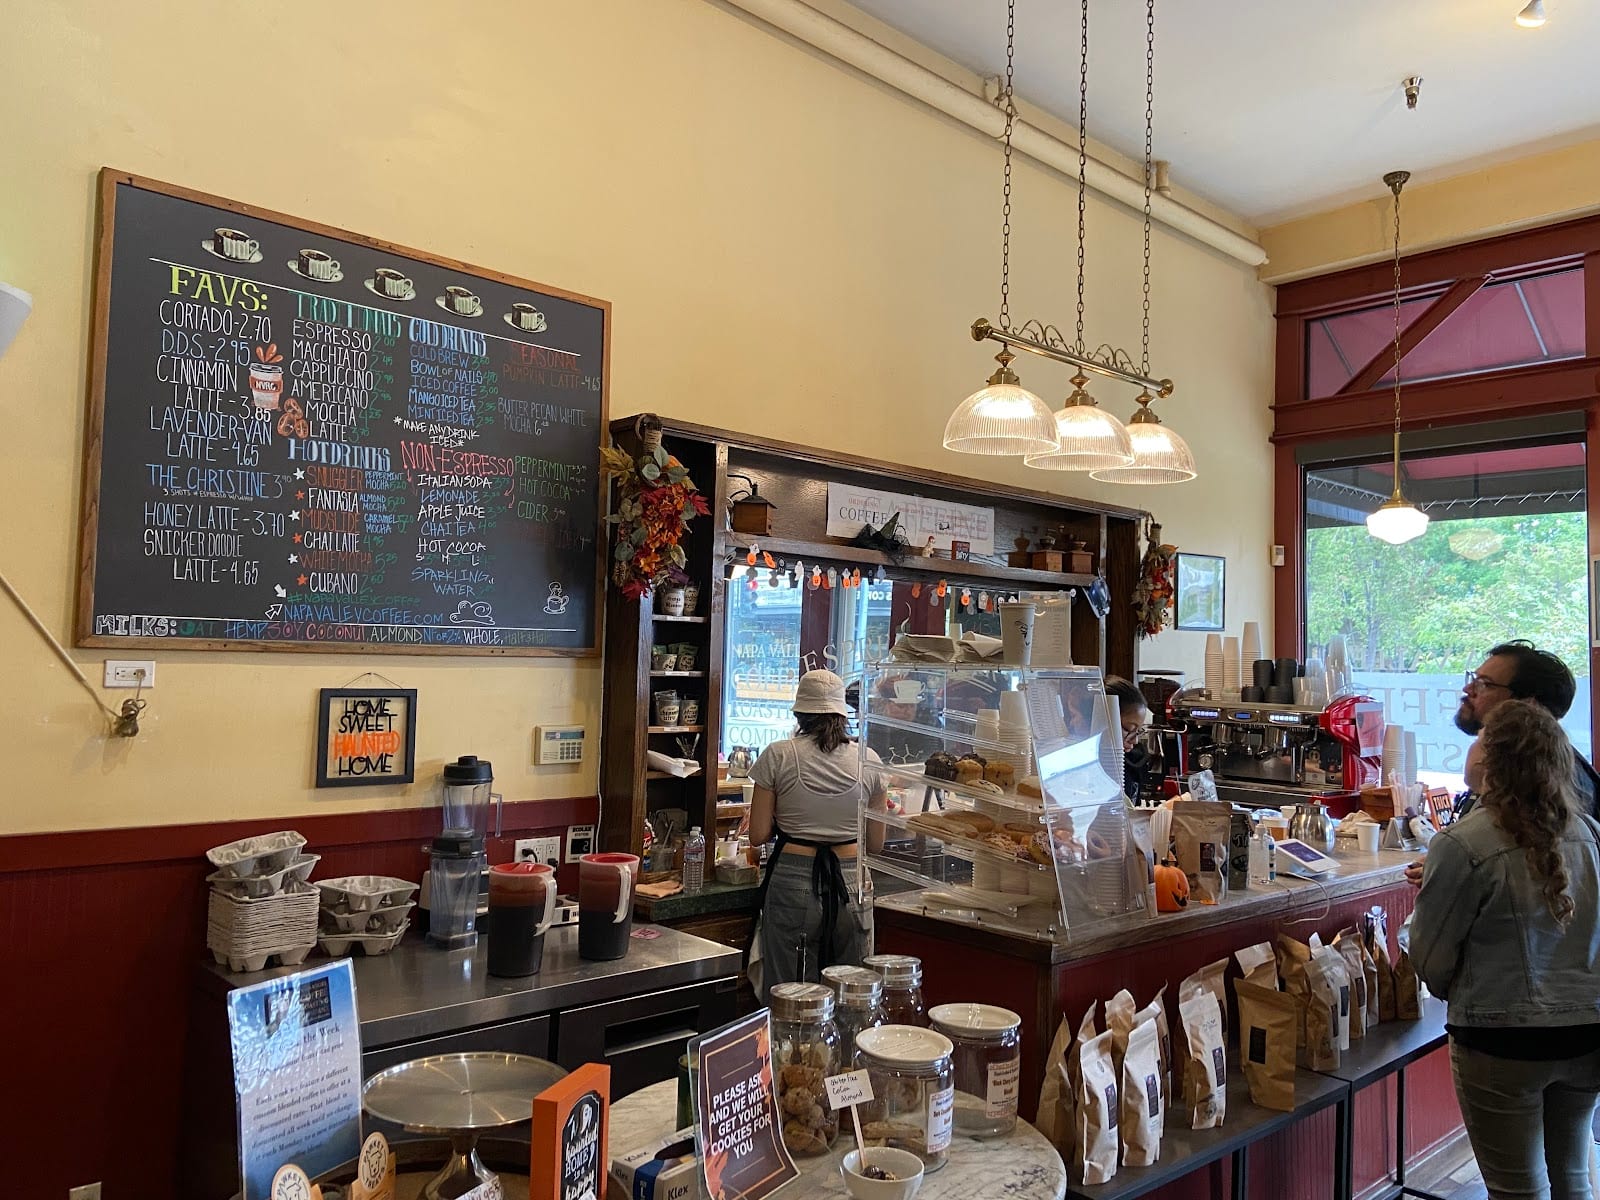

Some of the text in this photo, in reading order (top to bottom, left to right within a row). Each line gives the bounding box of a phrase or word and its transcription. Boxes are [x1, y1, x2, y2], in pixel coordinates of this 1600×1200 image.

[170, 265, 268, 312] FAVS:
[293, 319, 372, 351] ESPRESSO
[408, 317, 487, 357] COLD DRINKS
[292, 339, 367, 371] MACCHIATO
[410, 344, 469, 369] COLD BREW
[156, 355, 237, 392] CINNAMON
[290, 359, 373, 391] CAPPUCCINO
[410, 360, 442, 377] BOWL
[455, 370, 483, 385] NAILS
[551, 372, 581, 388] LATTE
[291, 379, 369, 409] AMERICANO
[412, 375, 477, 397] ICED COFFEE
[174, 386, 224, 414] LATTE
[408, 388, 441, 406] MANGO
[441, 394, 458, 408] ICED
[460, 397, 476, 412] TEA
[305, 401, 357, 426] MOCHA
[408, 405, 475, 427] MINT ICED TEA
[498, 397, 587, 427] BUTTER PECAN WHITE
[310, 421, 347, 442] LATTE
[428, 424, 448, 436] ANY
[448, 426, 480, 440] DRINK
[504, 414, 533, 435] MOCHA
[167, 432, 216, 461] LATTE
[400, 440, 514, 477] NON-ESPRESSO
[515, 456, 571, 481] PEPPERMINT
[145, 463, 181, 489] THE
[187, 466, 271, 499] CHRISTINE
[306, 466, 363, 491] SNUGGLER
[365, 479, 390, 490] MOCHA
[417, 474, 493, 488] ITALIAN SODA
[520, 477, 538, 495] HOT
[541, 481, 571, 501] COCOA
[171, 489, 191, 497] SHOTS
[308, 488, 359, 513] FANTASIA
[359, 494, 386, 502] ALMOND
[421, 488, 481, 505] LEMONADE
[144, 502, 194, 529] HONEY
[198, 505, 239, 531] LATTE
[362, 503, 387, 512] MOCHA
[364, 513, 397, 523] CARAMEL
[417, 504, 485, 522] APPLE JUICE
[517, 501, 549, 523] CIDER
[301, 509, 361, 533] MUDSLIDE
[366, 523, 392, 534] MOCHA
[421, 520, 476, 537] CHAI TEA
[144, 528, 244, 557] SNICKER DOODLE
[304, 531, 360, 552] CHAI LATTE
[418, 538, 487, 555] HOT COCOA
[309, 572, 358, 594] CUBANO
[411, 567, 489, 583] SPARKLING
[433, 582, 476, 597] WATER
[96, 615, 177, 636] MILKS:
[733, 644, 765, 658] NAPA
[345, 698, 392, 718] HOME
[338, 714, 397, 733] SWEET
[333, 730, 400, 760] HAUNTED
[338, 754, 395, 776] HOME
[713, 1074, 763, 1109] PLEASE ASK
[709, 1088, 770, 1125] AND WE WILL
[718, 1117, 737, 1136] GET
[738, 1104, 763, 1128] YOUR
[711, 1126, 752, 1155] COOKIES
[753, 1112, 771, 1133] FOR
[733, 1138, 754, 1160] YOU
[565, 1147, 589, 1178] HOME
[668, 1184, 690, 1200] Klex
